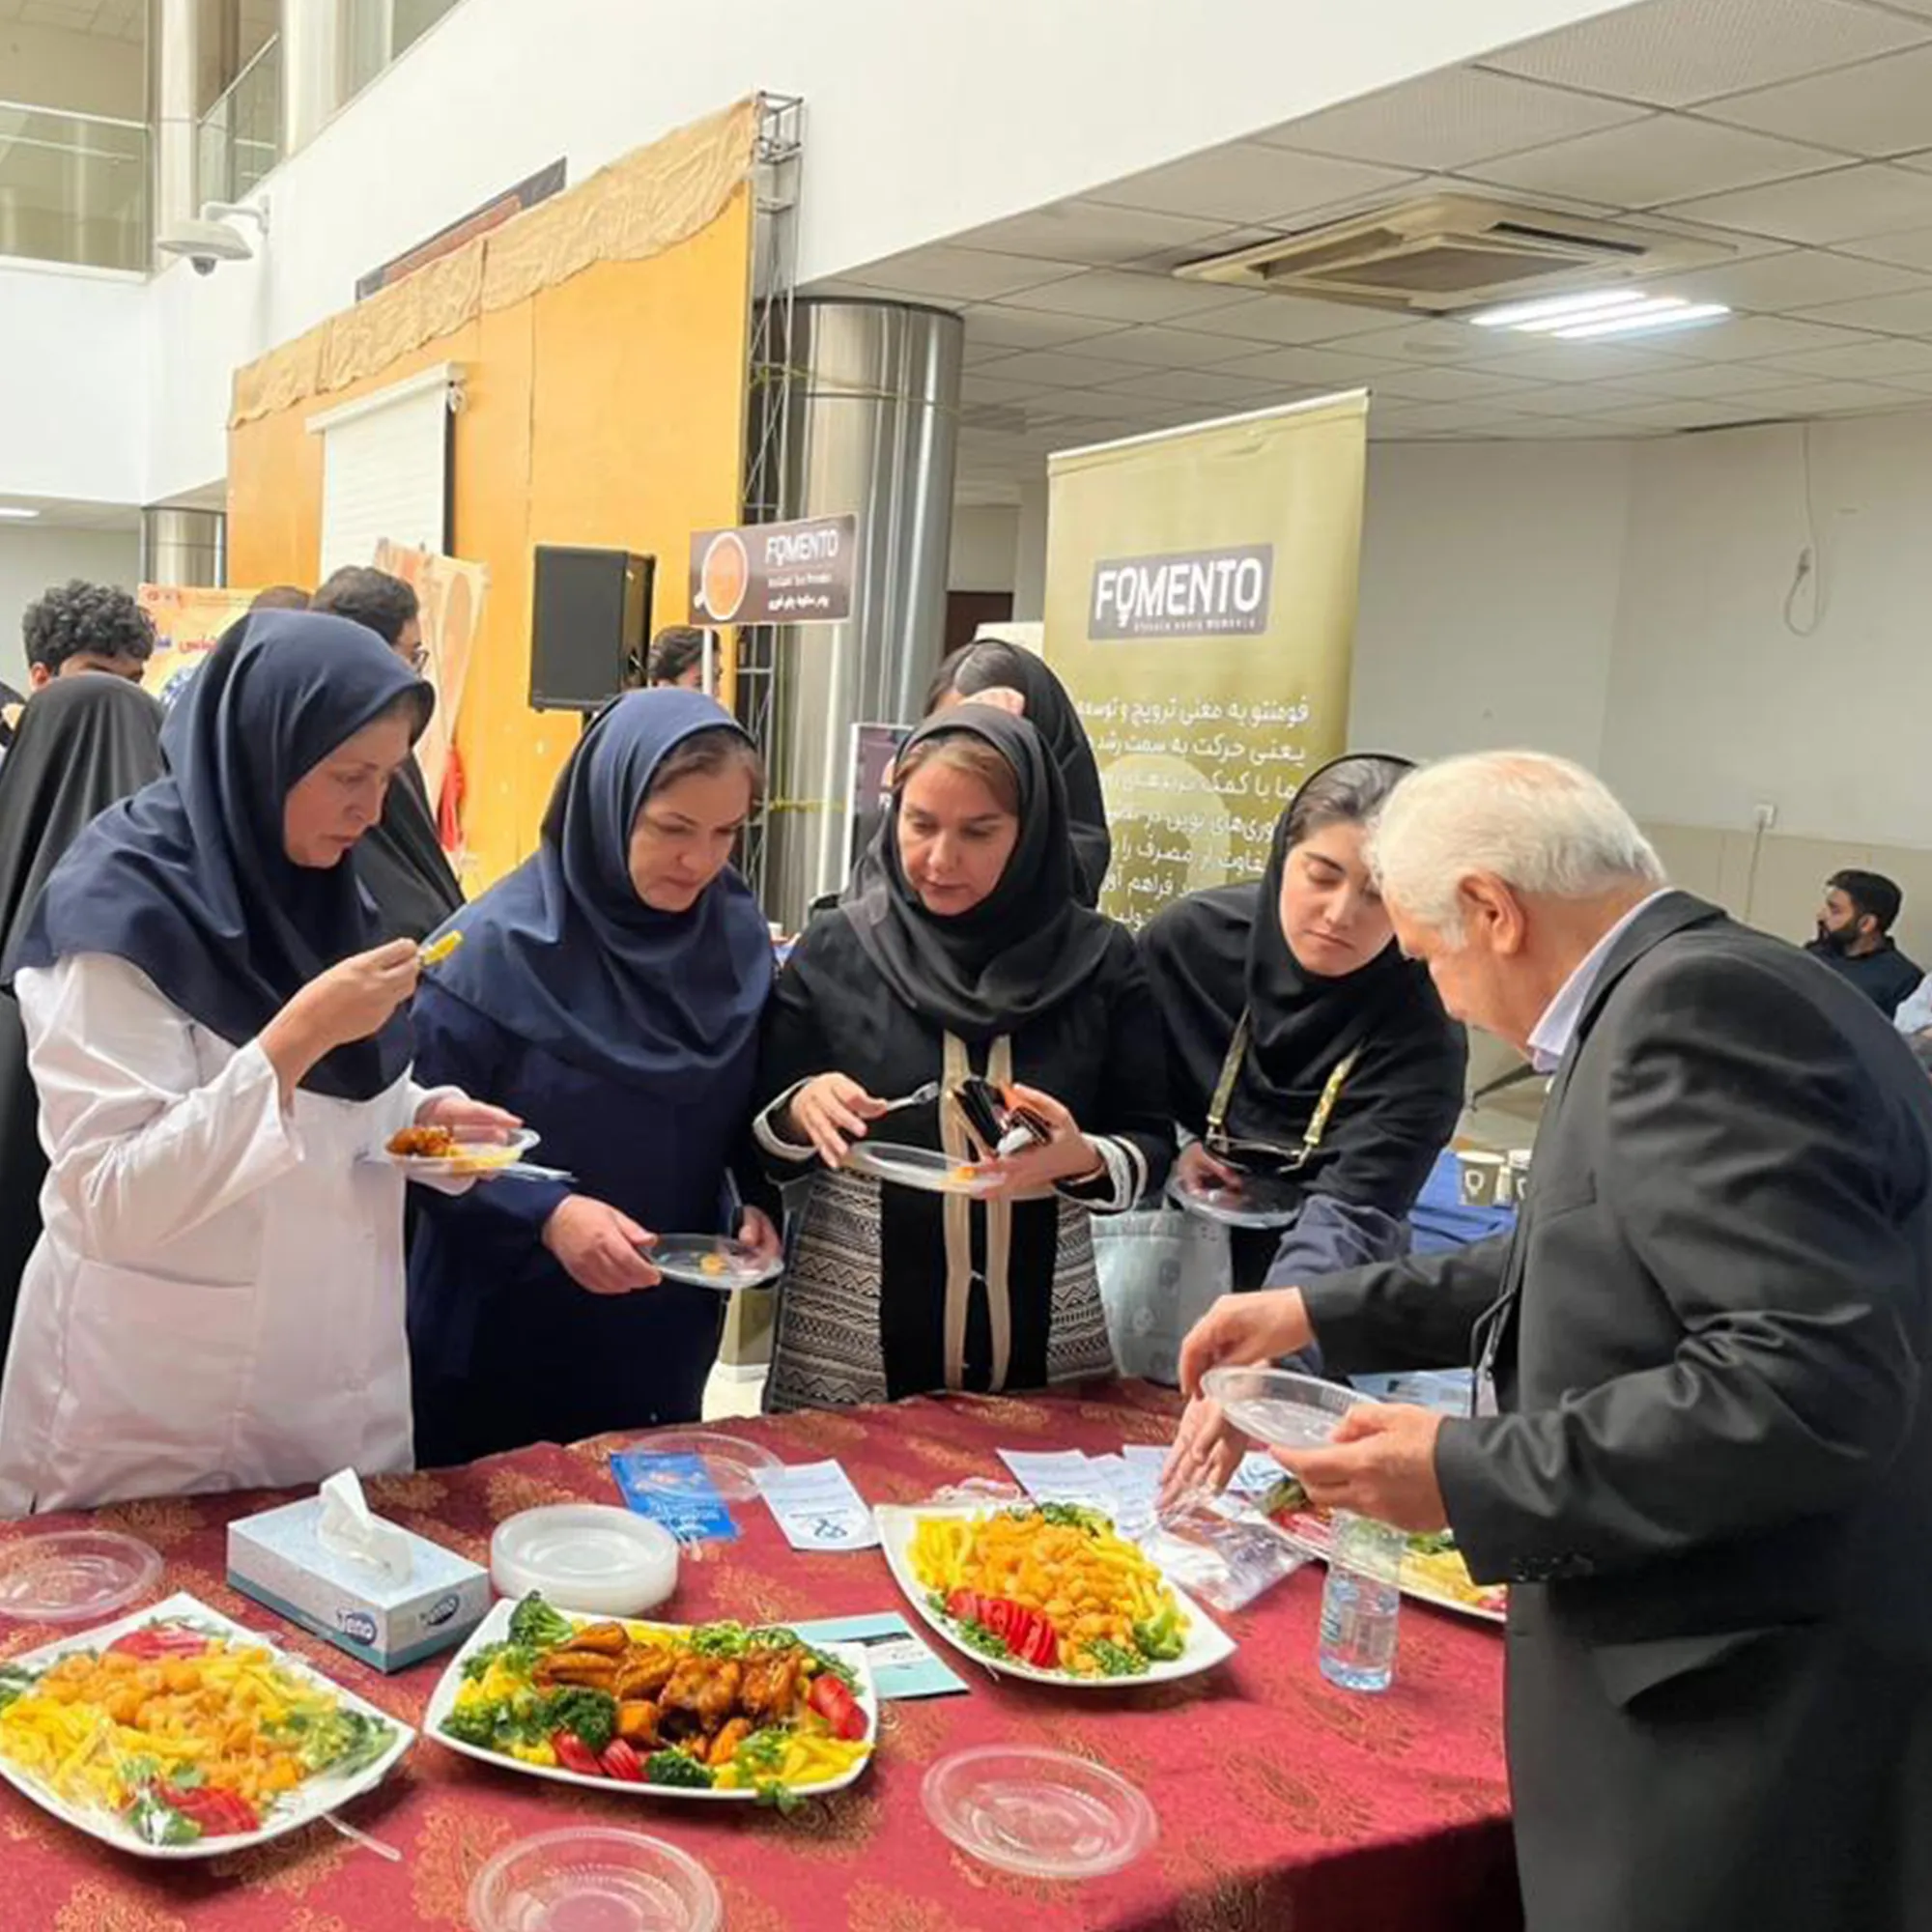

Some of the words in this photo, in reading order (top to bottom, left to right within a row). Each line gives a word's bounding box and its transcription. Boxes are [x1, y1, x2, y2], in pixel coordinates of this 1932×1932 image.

[765, 529, 838, 567] FOMENTO
[1094, 556, 1264, 628] FOMENTO
[1124, 736, 1167, 752] سمت
[1172, 738, 1188, 754] به
[1193, 732, 1246, 763] حرکت
[1127, 869, 1174, 900] فراهم
